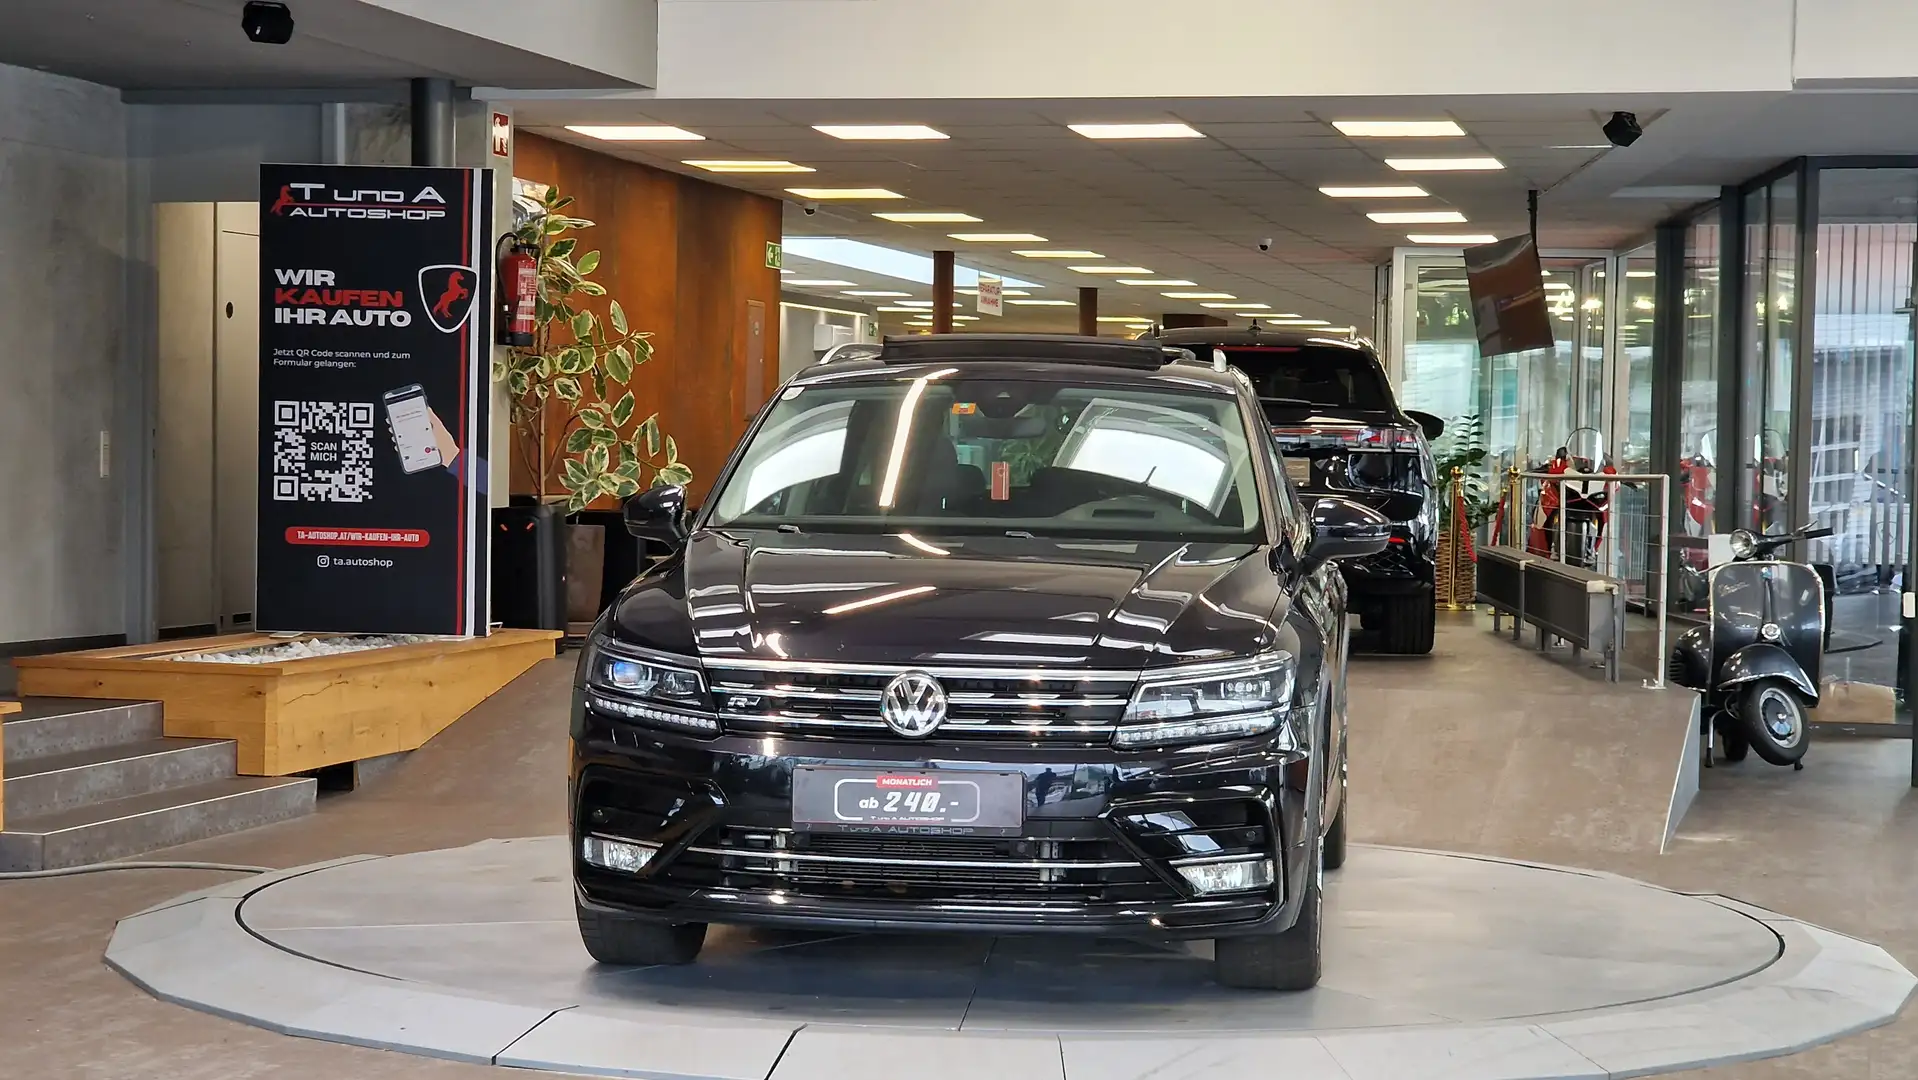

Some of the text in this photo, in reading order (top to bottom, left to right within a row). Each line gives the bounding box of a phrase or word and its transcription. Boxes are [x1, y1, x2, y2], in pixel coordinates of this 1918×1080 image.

[289, 182, 326, 200] T
[411, 186, 447, 204] A
[289, 207, 446, 220] AUTOSHOP
[274, 268, 336, 286] WIR
[274, 288, 403, 308] KAUFEN
[274, 307, 412, 327] IHR AUTO
[273, 348, 295, 356] Jetzt
[296, 349, 310, 357] QR
[311, 349, 333, 357] Code
[335, 350, 371, 358] scannen
[373, 351, 390, 359] und
[273, 358, 357, 369] Formular gelangen:
[310, 442, 338, 451] SCAN
[310, 452, 338, 461] MICH
[296, 530, 420, 542] TA-AUTOSHOP.AT/WIR-KAUFEN-IHR-AUTO
[333, 557, 394, 568] ta.autoshop
[882, 778, 933, 787] MONATLICH
[858, 791, 959, 813] ab 240.-
[887, 826, 975, 836] AUTOSHOP
